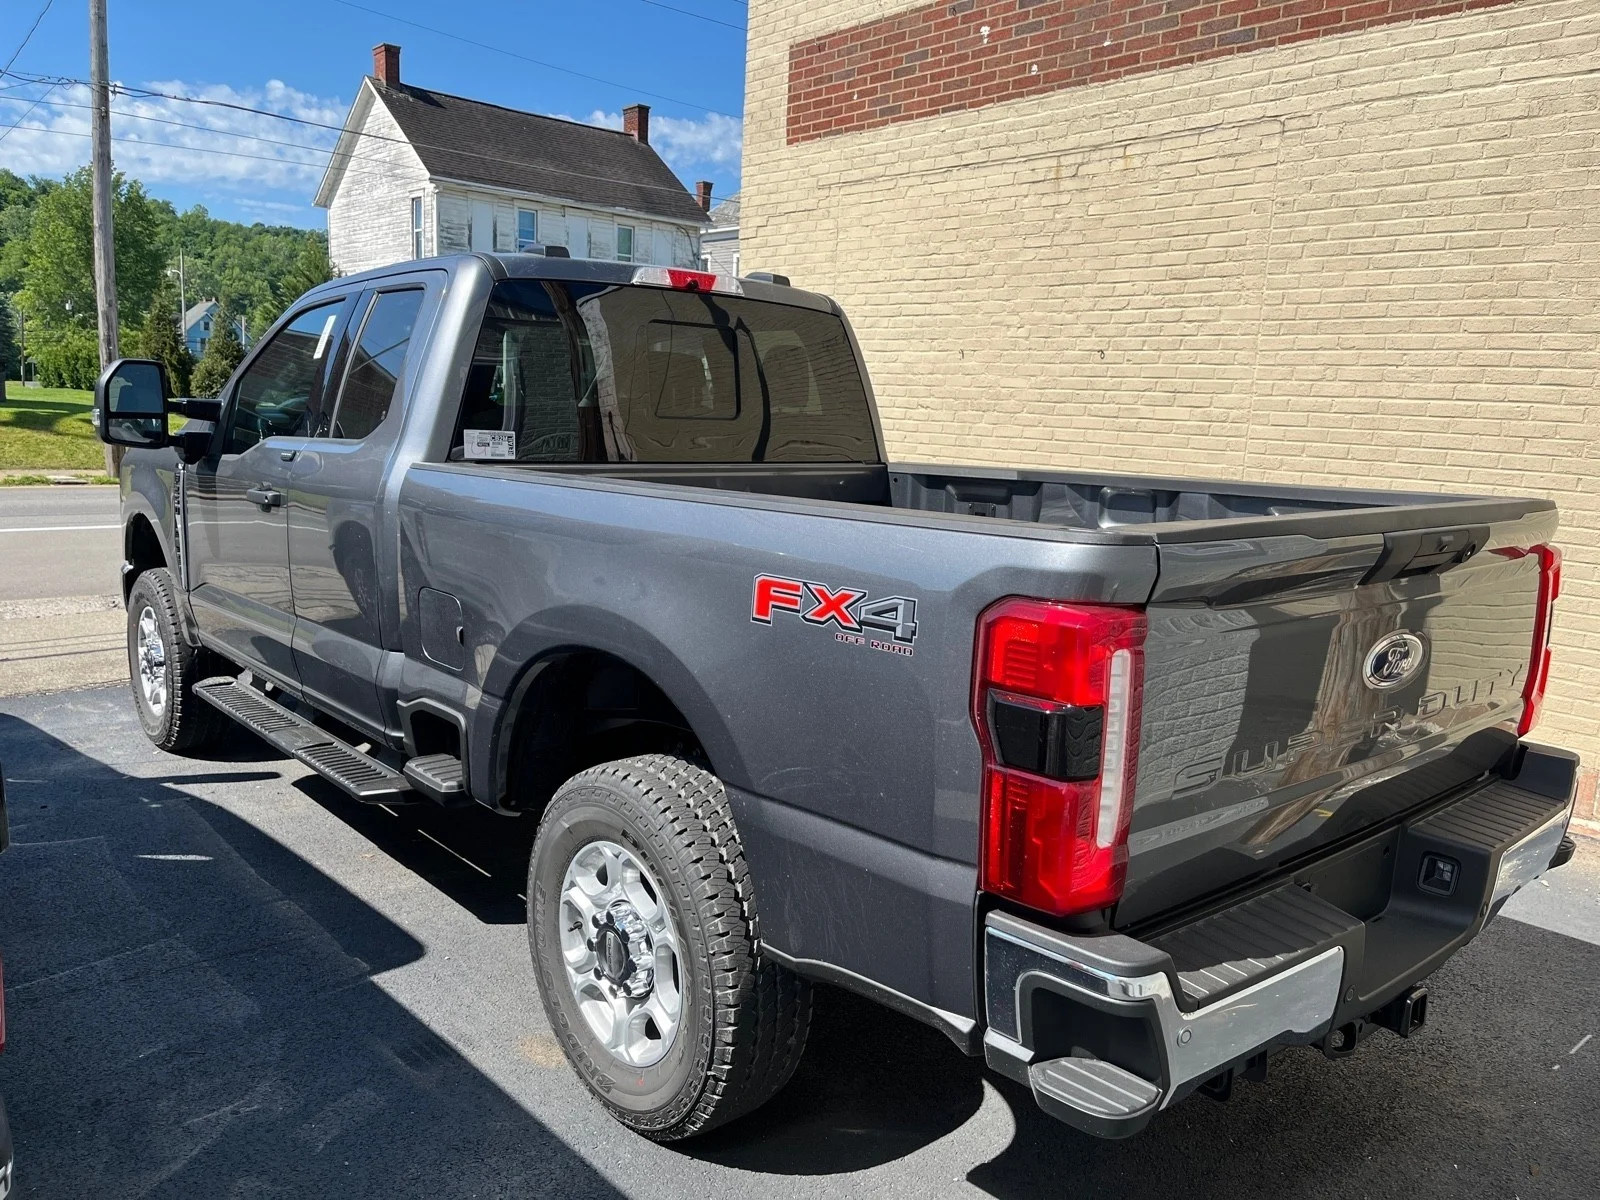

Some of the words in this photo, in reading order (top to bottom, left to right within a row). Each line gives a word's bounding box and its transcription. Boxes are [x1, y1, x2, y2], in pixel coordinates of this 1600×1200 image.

[751, 572, 918, 645] FX4
[835, 632, 865, 645] OFF
[870, 640, 914, 656] ROAD
[1417, 663, 1523, 721] DUTY
